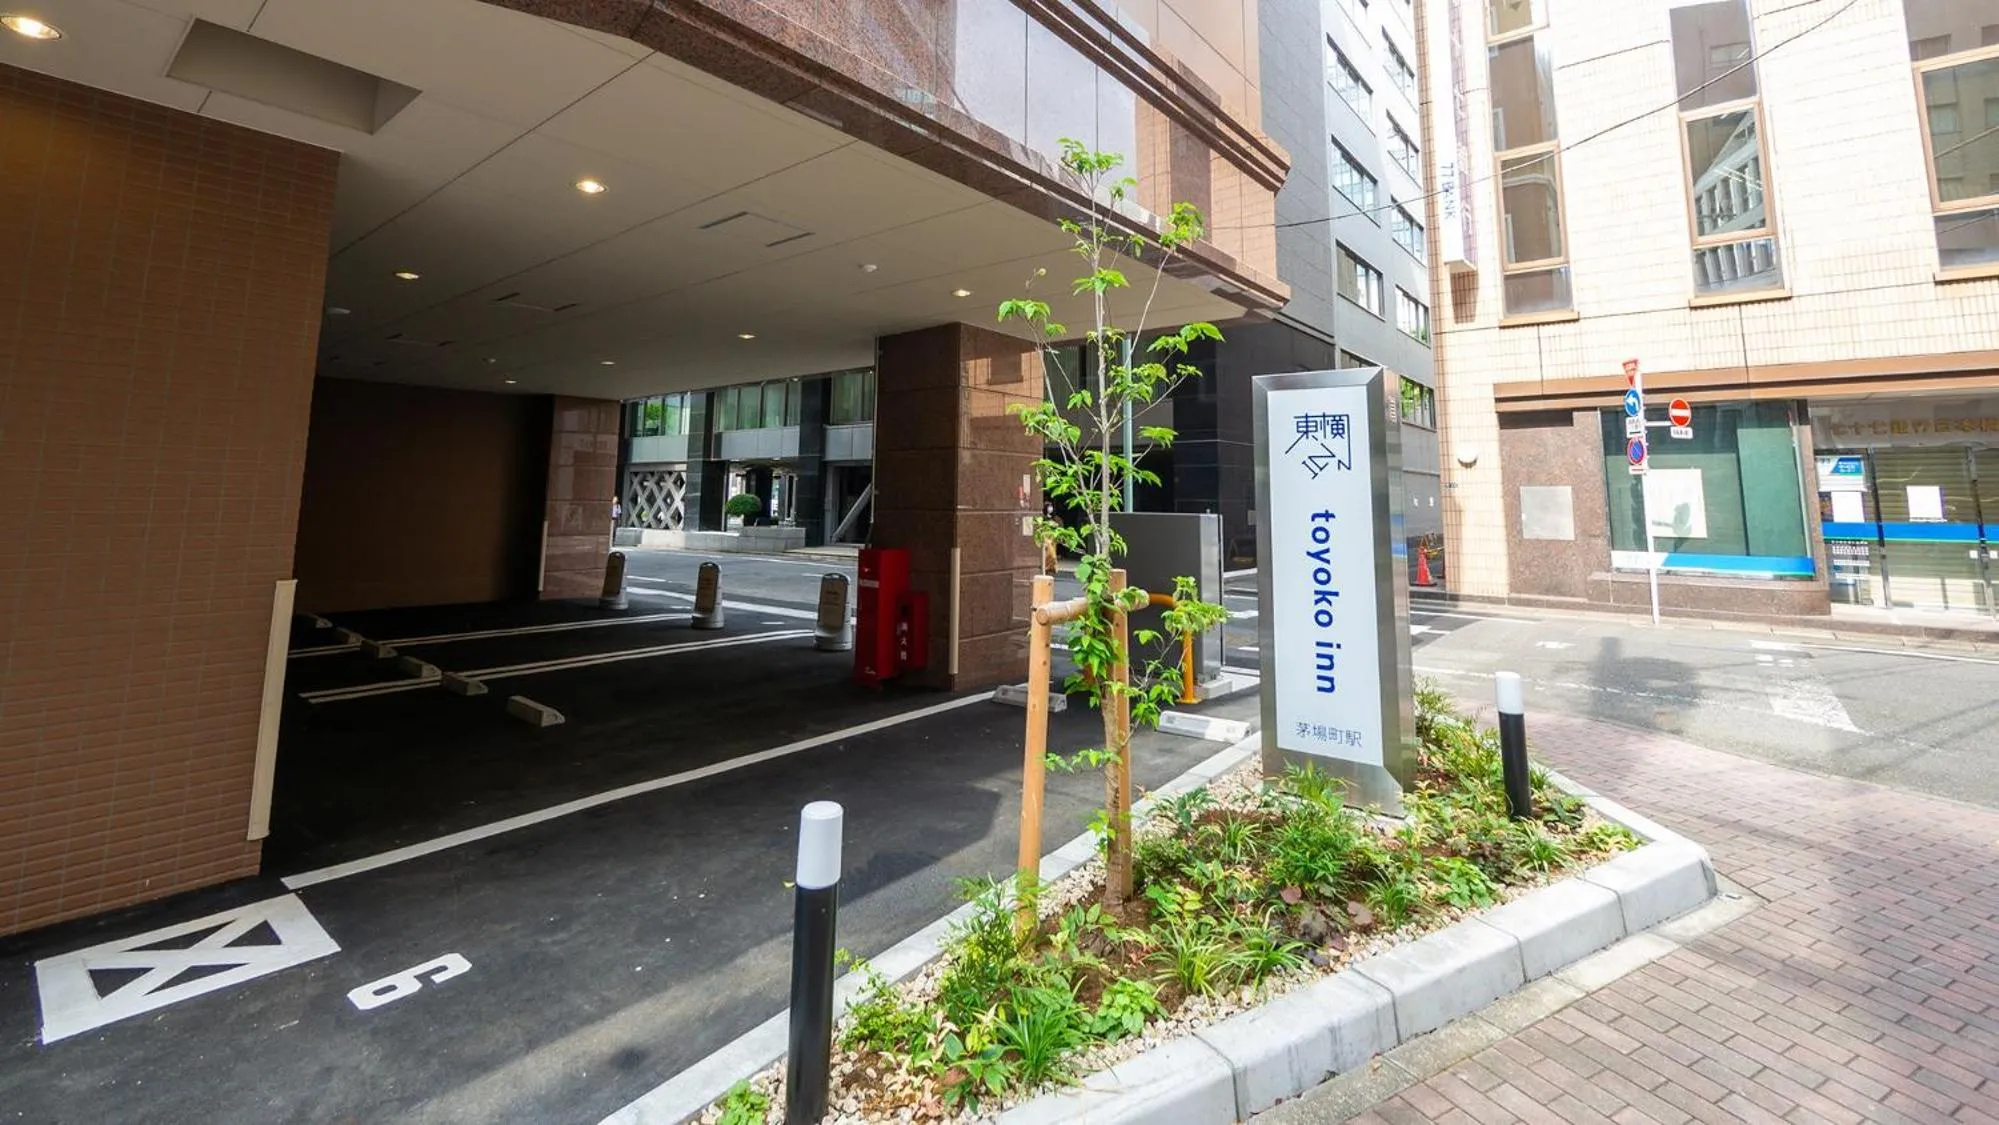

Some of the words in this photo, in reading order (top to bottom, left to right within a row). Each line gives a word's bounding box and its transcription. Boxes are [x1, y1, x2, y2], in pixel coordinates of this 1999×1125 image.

[1306, 509, 1340, 629] toyoko
[1314, 640, 1342, 694] inn
[1295, 721, 1362, 747] 茅場町駅
